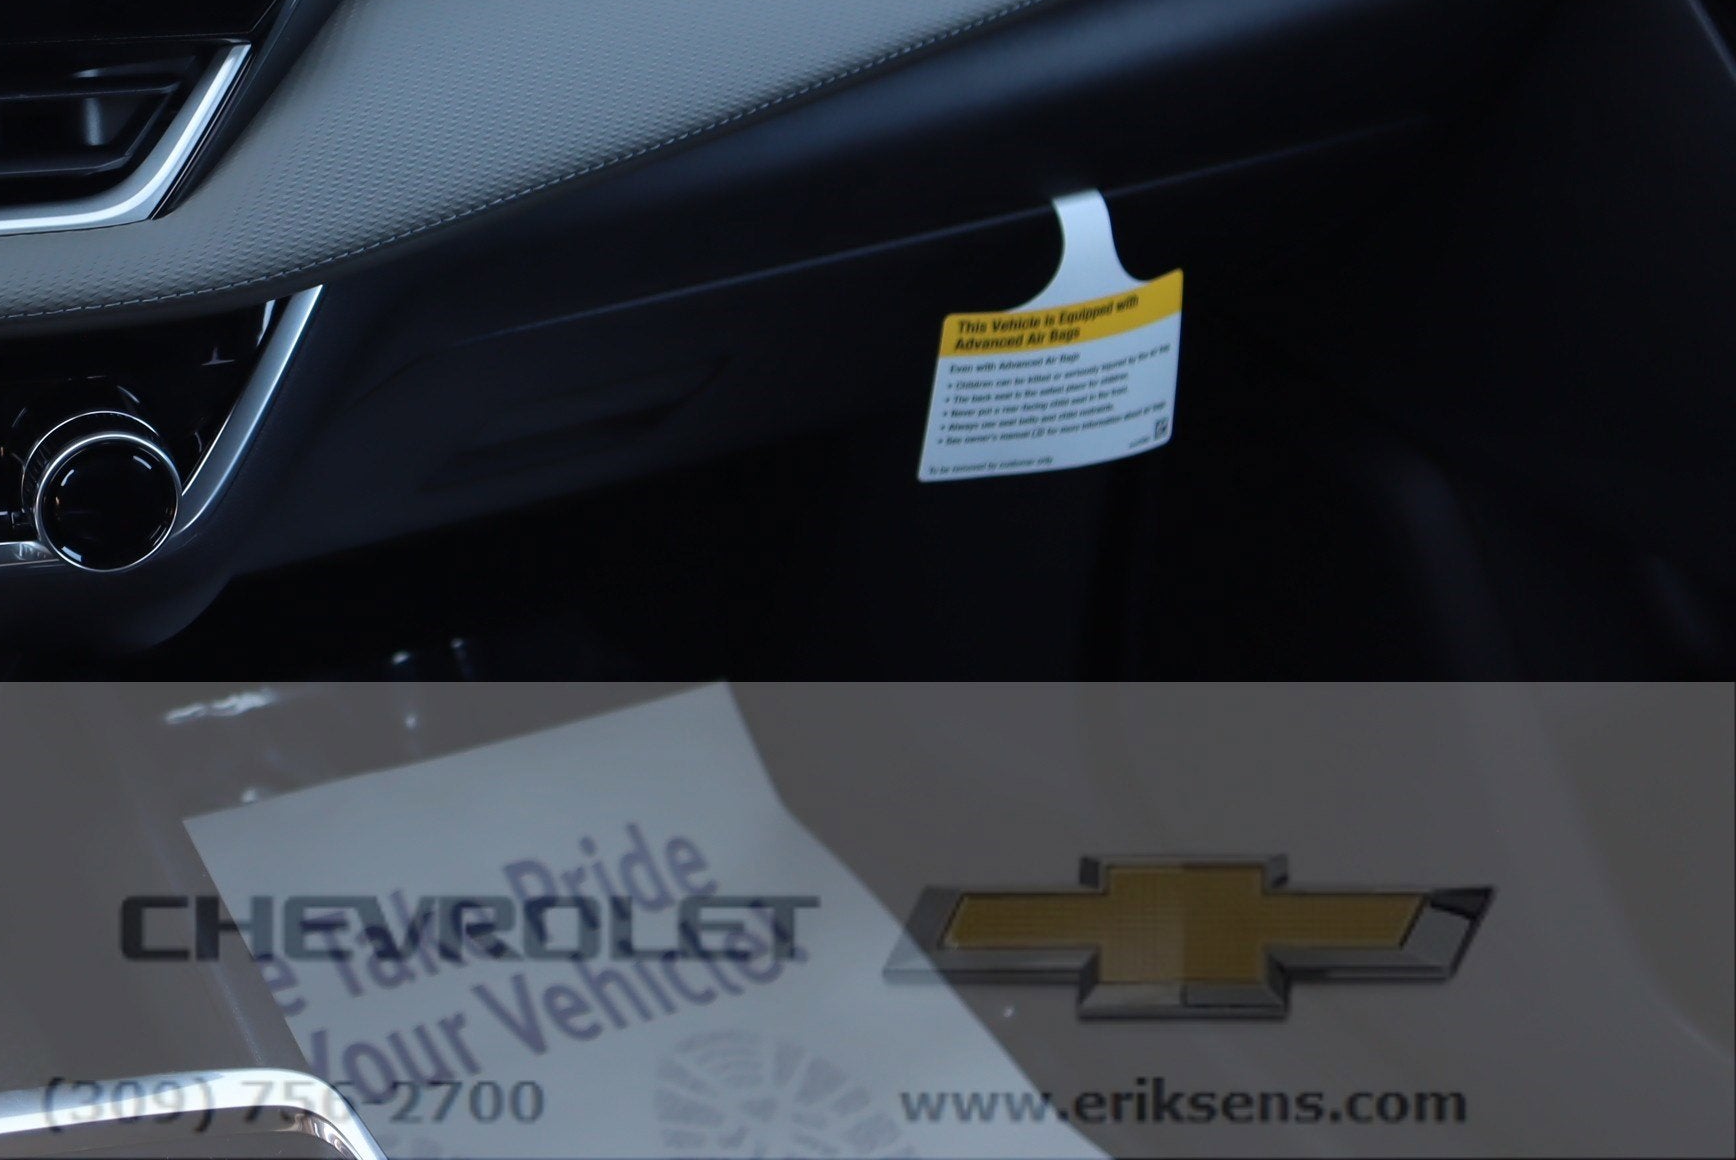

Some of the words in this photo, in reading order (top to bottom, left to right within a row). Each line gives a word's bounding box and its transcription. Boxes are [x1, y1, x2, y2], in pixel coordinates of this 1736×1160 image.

[958, 319, 987, 333] This
[992, 316, 1041, 332] Vehicle
[1059, 301, 1114, 324] Equipped
[1115, 294, 1139, 312] with
[954, 335, 1025, 351] Advanced
[1027, 332, 1045, 345] Air
[1049, 326, 1081, 344] Bags
[300, 888, 510, 1000] Take
[502, 821, 720, 947] Pride
